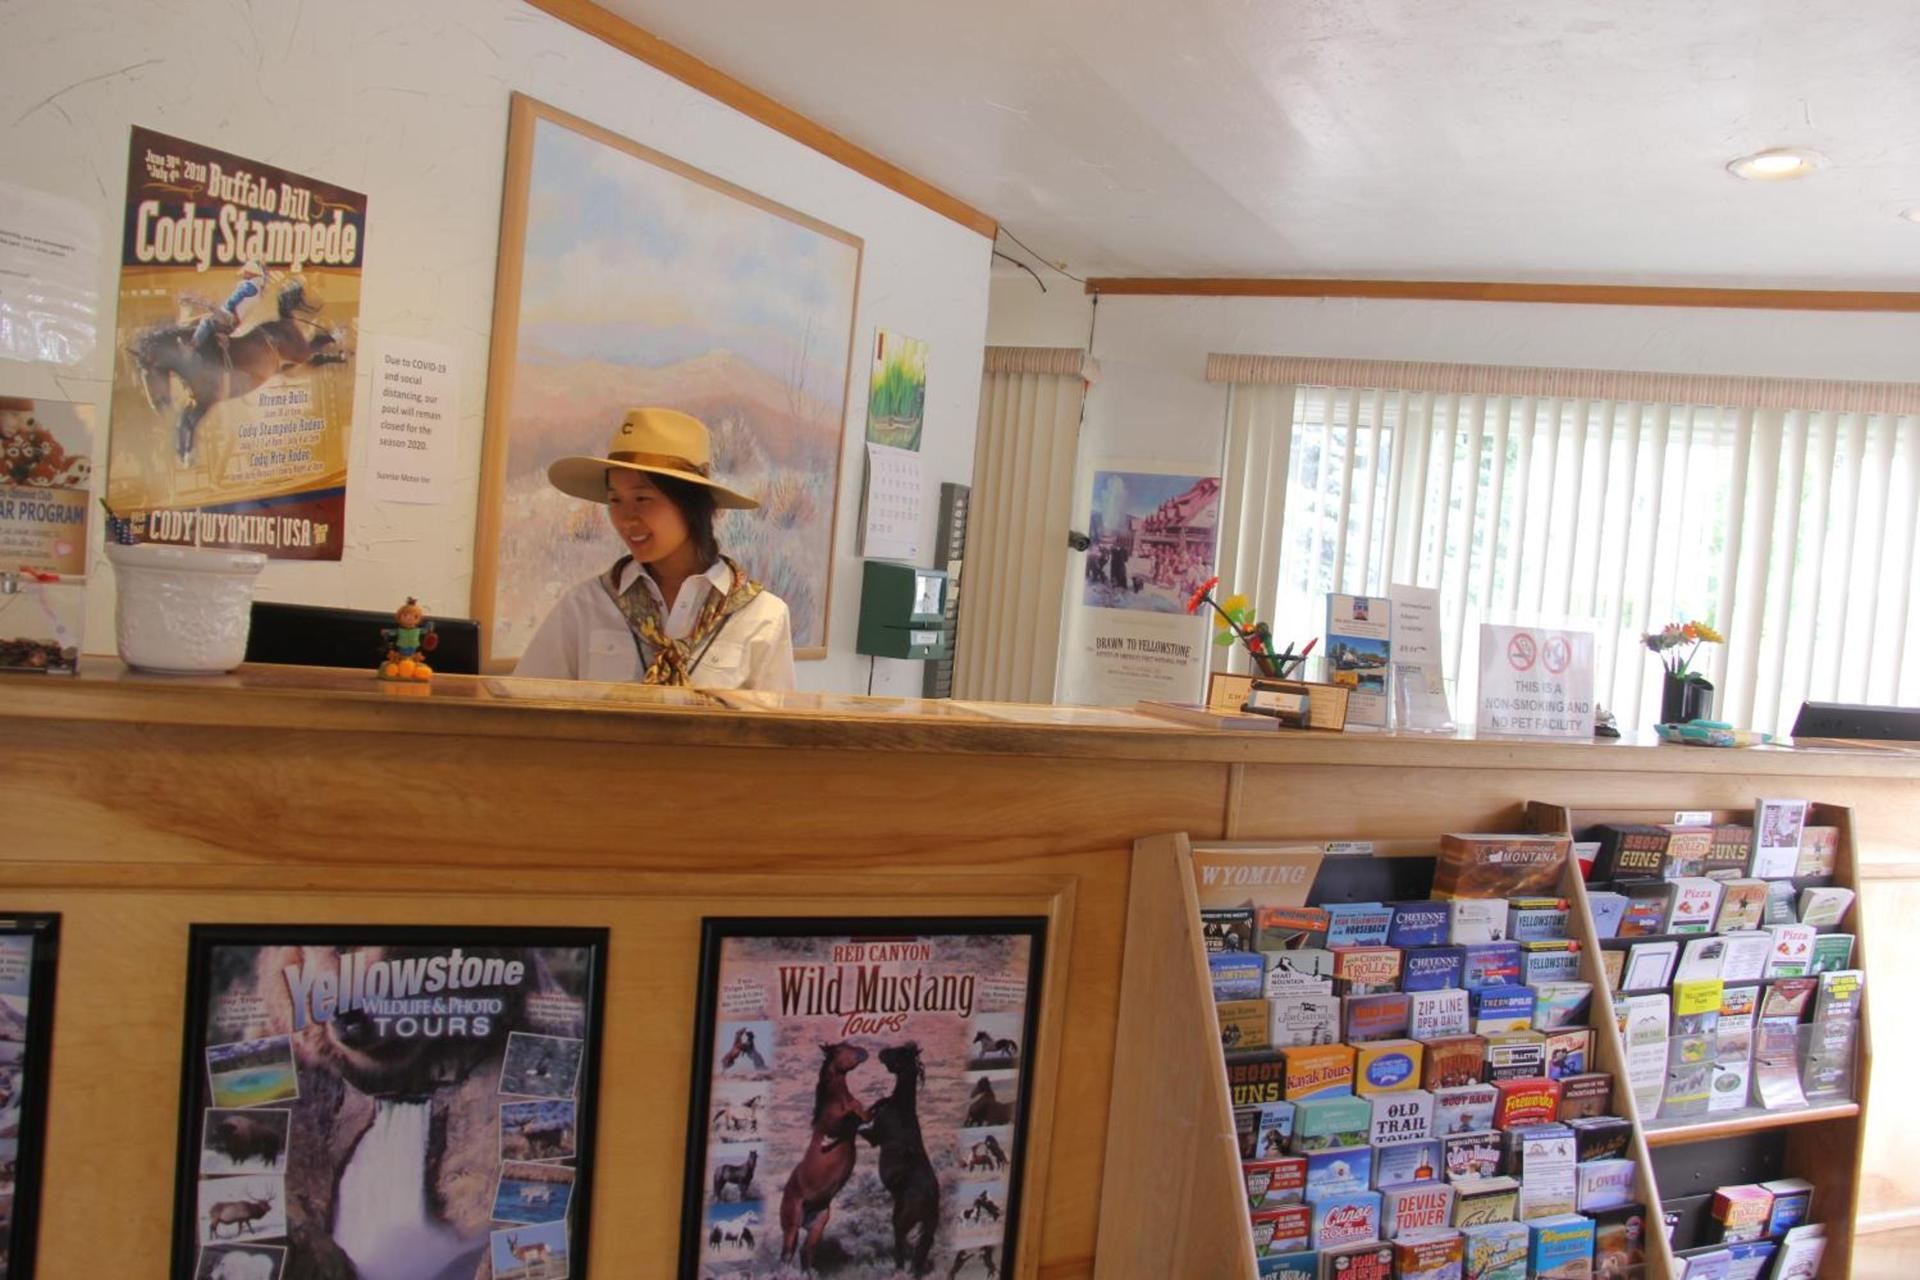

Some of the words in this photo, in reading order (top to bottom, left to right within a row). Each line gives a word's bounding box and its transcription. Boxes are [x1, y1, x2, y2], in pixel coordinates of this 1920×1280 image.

[207, 162, 277, 213] Buffalo
[279, 183, 310, 222] Bill
[136, 201, 216, 273] Cody
[216, 204, 357, 273] Stampede
[384, 354, 400, 365] Due
[402, 358, 411, 367] to
[384, 372, 398, 381] and
[401, 375, 422, 385] social
[381, 405, 399, 414] pool
[400, 408, 415, 417] will
[416, 410, 441, 420] remain
[239, 424, 257, 438] Cody
[259, 421, 297, 436] Stampede
[380, 420, 405, 432] closed
[407, 423, 418, 433] for
[419, 425, 432, 435] the
[622, 422, 634, 436] C
[379, 438, 406, 448] season
[19, 502, 84, 524] PROGRAM
[150, 510, 194, 541] CODY
[201, 513, 276, 545] WYOMING
[282, 518, 311, 546] USA
[1096, 637, 1123, 650] DRAWN
[1127, 638, 1137, 650] TO
[1139, 639, 1191, 658] YELLOWSTONE
[1514, 681, 1539, 693] THIS
[1542, 683, 1553, 693] IS
[1554, 683, 1563, 694] A
[1485, 698, 1564, 713] NON-SMOKING
[1568, 702, 1589, 714] AND
[1491, 716, 1508, 728] NO
[1511, 717, 1533, 729] PET
[1535, 718, 1582, 731] FACILITY
[1624, 835, 1667, 849] SHOOT
[1501, 852, 1558, 863] MONTANA
[1620, 851, 1661, 867] GUNS
[1202, 865, 1306, 886] WYOMING
[1684, 888, 1712, 898] Pizza
[1396, 912, 1446, 924] CHEYENNE
[1519, 915, 1566, 928] YELLOWSTONE
[1782, 930, 1808, 941] Pizza
[833, 945, 864, 963] RED
[868, 944, 931, 962] CANYON
[1344, 962, 1394, 977] TROLLEY
[1409, 956, 1459, 969] CHEYENNE
[1529, 956, 1578, 970] YELLOWSTONE
[283, 948, 526, 1033] Yellowstone
[778, 965, 843, 1016] Wild
[853, 965, 976, 1018] Mustang
[362, 998, 431, 1015] WILDLIFE
[432, 998, 447, 1014] &
[447, 998, 503, 1015] PHOTO
[1418, 1000, 1435, 1015] ZIP
[1439, 998, 1463, 1013] LINE
[374, 1015, 491, 1038] TOURS
[838, 1011, 908, 1038] Tours
[1417, 1016, 1438, 1028] OPEN
[1441, 1014, 1463, 1026] DAILY
[1287, 1070, 1320, 1090] Kayak
[1322, 1066, 1352, 1080] Tours
[1233, 1083, 1280, 1104] UNS
[1442, 1096, 1469, 1107] BOOT
[1469, 1094, 1495, 1105] BARN
[1388, 1102, 1420, 1118] OLD
[1376, 1117, 1428, 1135] TRAIL
[1398, 1193, 1447, 1213] DEVILS
[1396, 1209, 1445, 1229] TOWER
